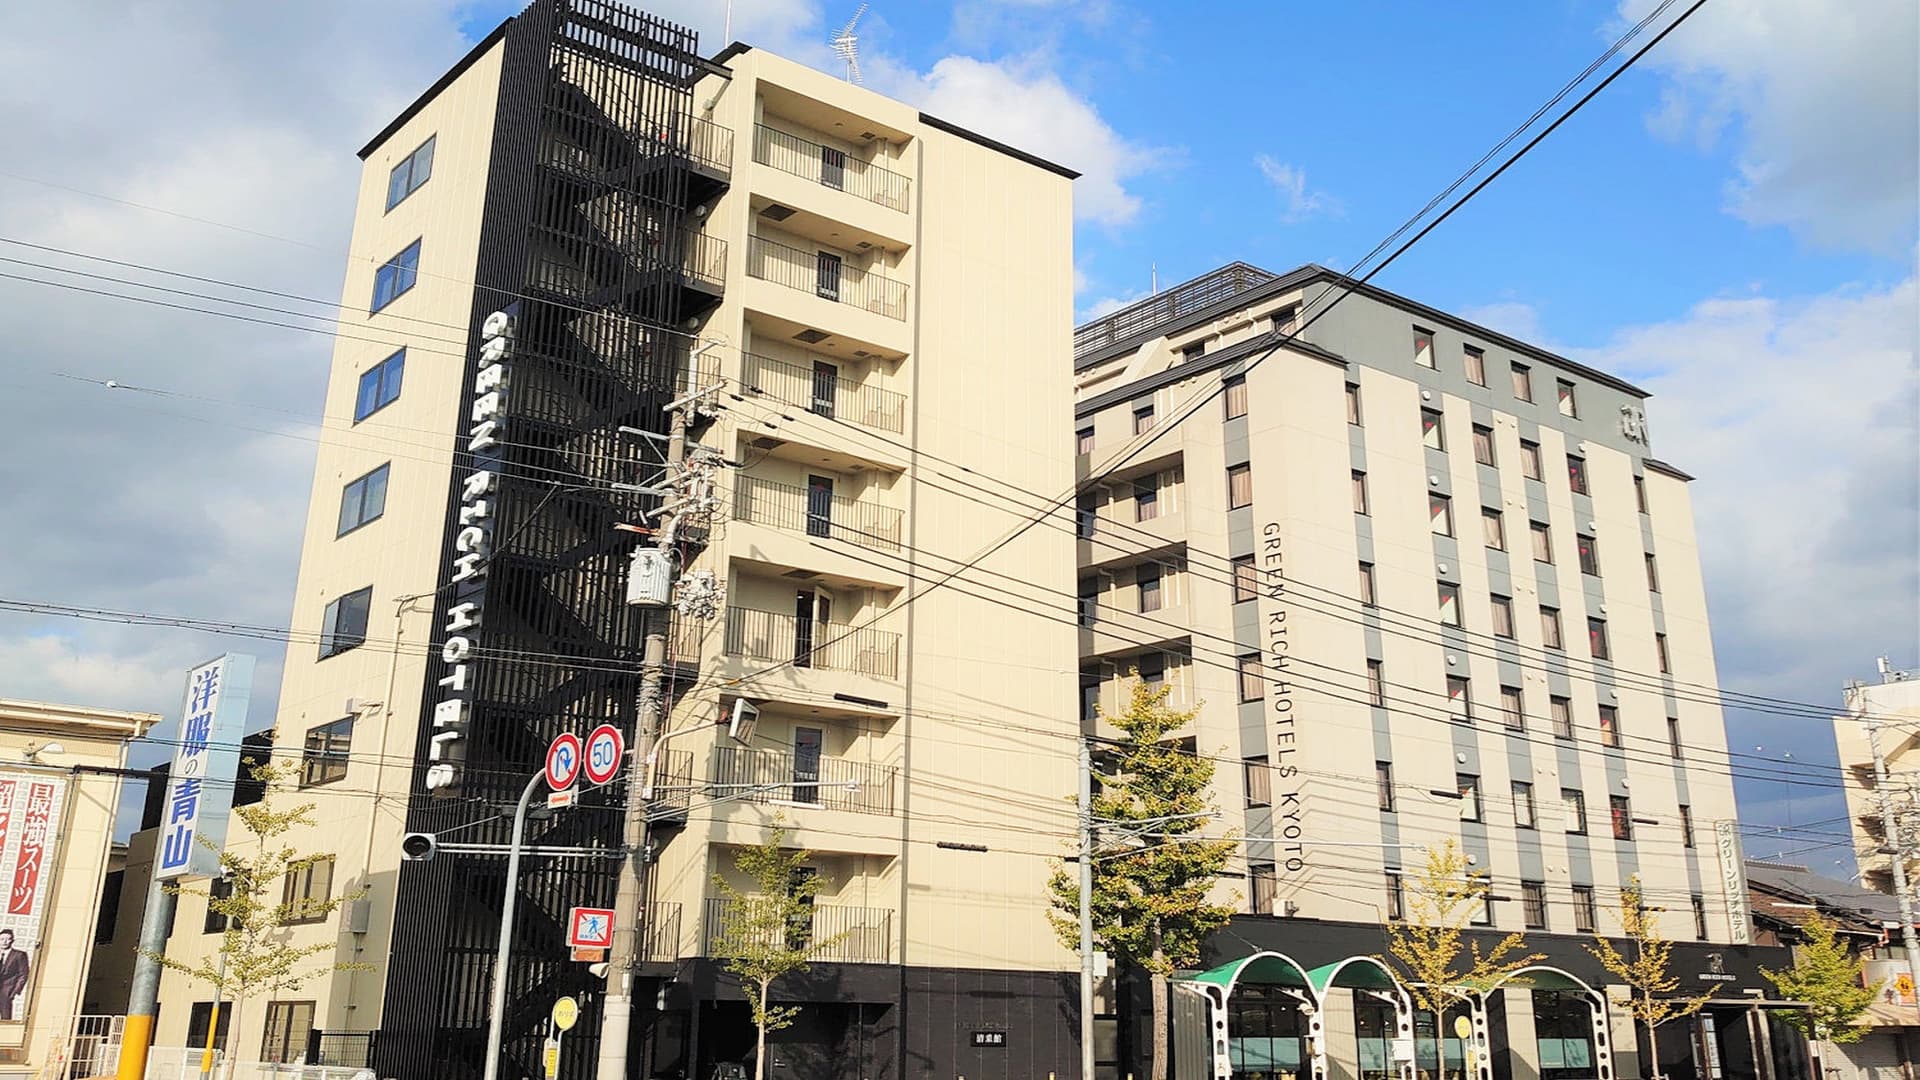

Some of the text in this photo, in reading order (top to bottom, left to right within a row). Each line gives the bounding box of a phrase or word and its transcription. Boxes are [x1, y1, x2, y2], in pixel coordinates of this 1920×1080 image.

[426, 310, 508, 789] GREEN RICH HOTELS
[162, 666, 219, 870] 洋服の青山
[593, 741, 613, 767] 50
[1264, 522, 1303, 872] GREEN RICH HOTELS KYOTO
[12, 784, 51, 912] 最強スーツ
